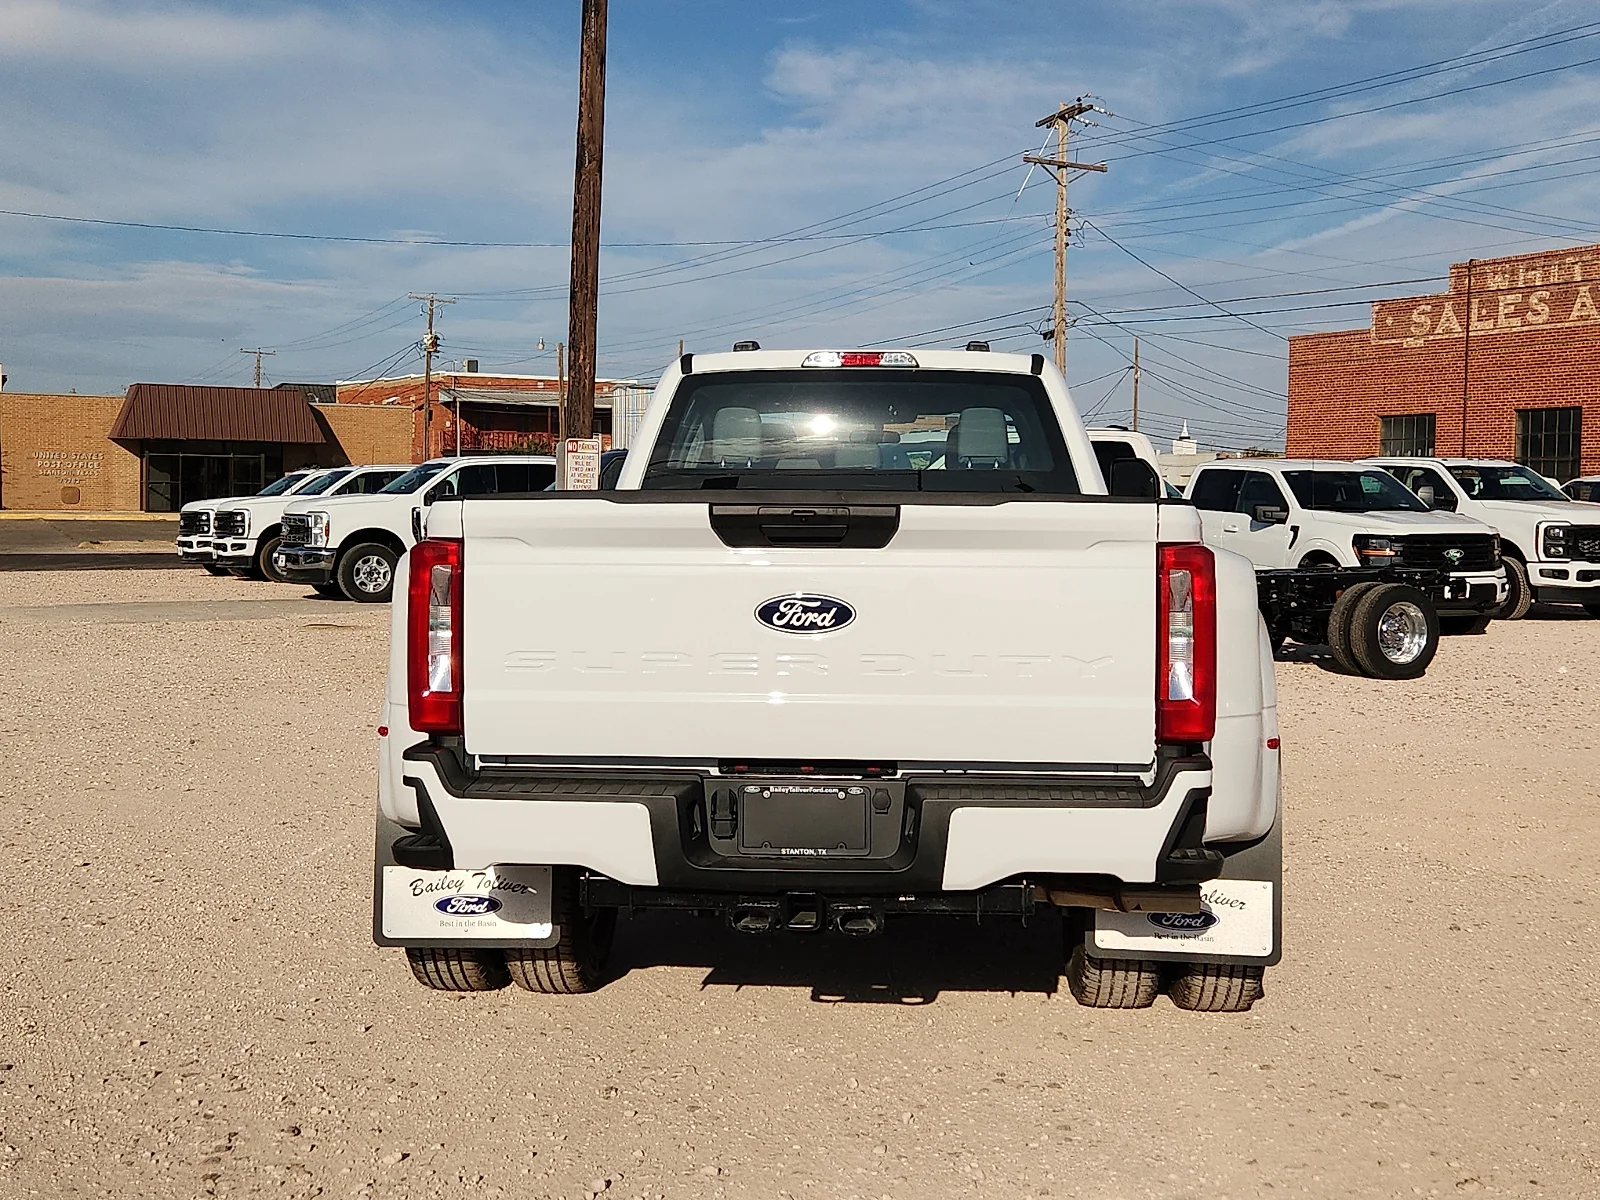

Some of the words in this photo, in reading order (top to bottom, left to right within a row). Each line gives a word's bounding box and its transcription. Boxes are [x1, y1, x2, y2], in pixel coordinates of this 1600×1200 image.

[1410, 290, 1550, 335] SALES
[568, 442, 577, 451] NO
[579, 443, 598, 451] PARKING
[34, 451, 68, 460] UNITED
[71, 452, 104, 460] STATES
[37, 460, 61, 468] POST
[65, 461, 101, 469] OFFICE
[772, 600, 838, 626] Ford
[505, 650, 828, 676] SUPER
[860, 653, 1114, 678] DUTY
[769, 786, 839, 794] BaileyToliverFord.com
[780, 848, 817, 856] STANTON,
[409, 875, 464, 896] Bailey
[472, 872, 529, 895] Toliver
[1199, 885, 1246, 910] oliver
[446, 898, 489, 912] Ford
[1162, 912, 1205, 926] Ford
[1194, 933, 1214, 942] Basin
